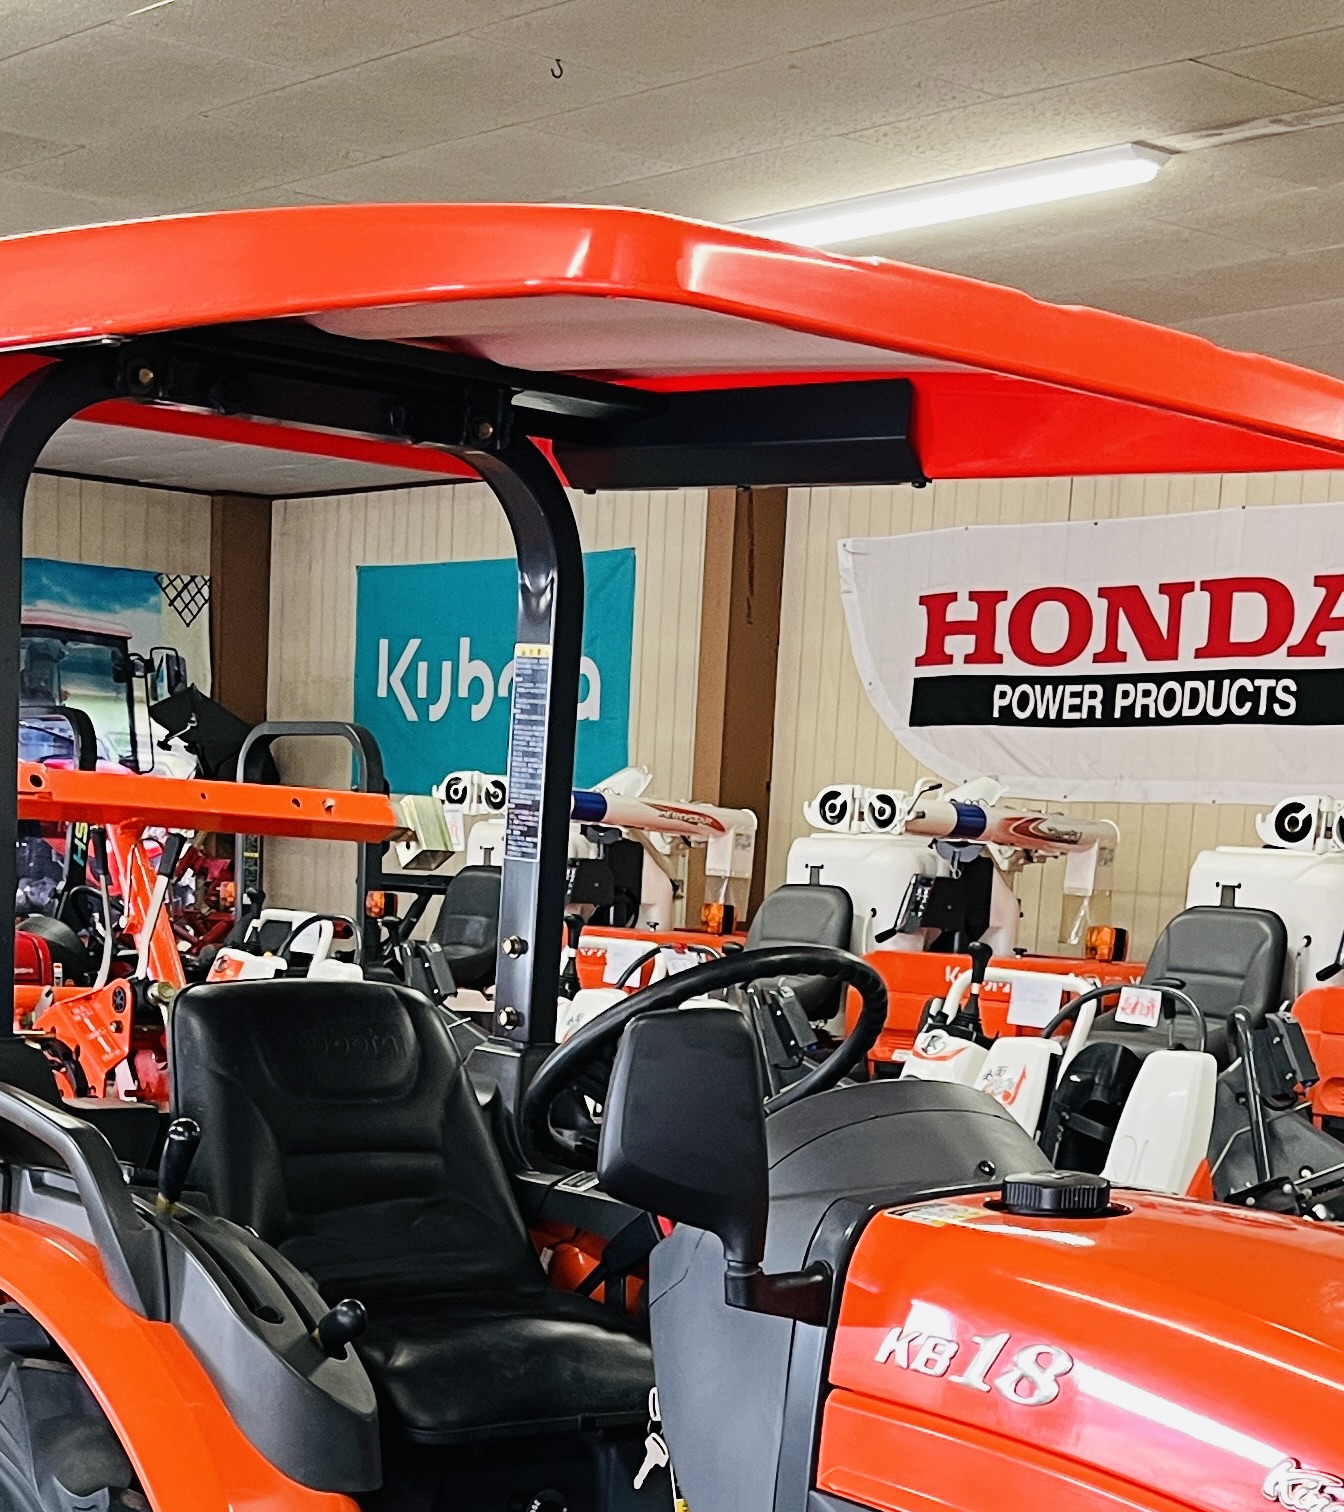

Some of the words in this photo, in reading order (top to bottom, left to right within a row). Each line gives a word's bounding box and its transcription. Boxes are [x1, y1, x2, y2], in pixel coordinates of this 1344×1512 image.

[377, 637, 601, 722] Kuba
[992, 683, 1102, 719] POWER
[1113, 678, 1297, 719] PRODUCTS
